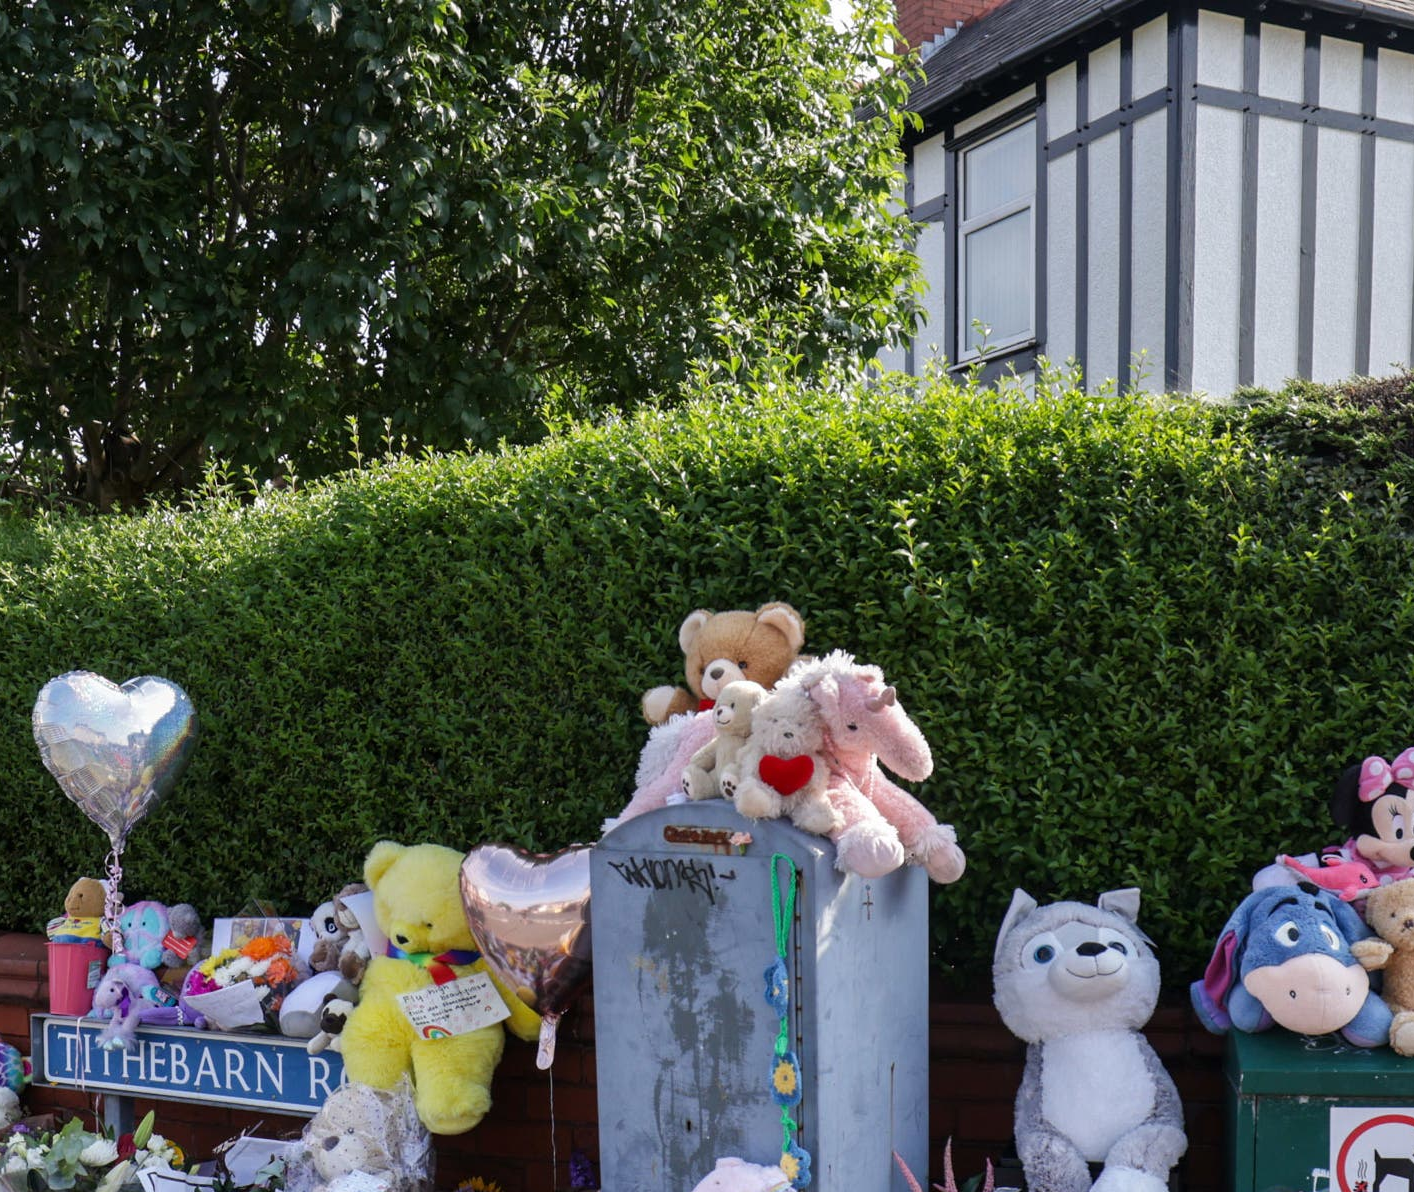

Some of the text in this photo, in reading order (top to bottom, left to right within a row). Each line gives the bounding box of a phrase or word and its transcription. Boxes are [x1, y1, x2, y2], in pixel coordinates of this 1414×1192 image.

[402, 994, 424, 1004] Fly
[58, 1032, 347, 1100] TITHEBARN R
